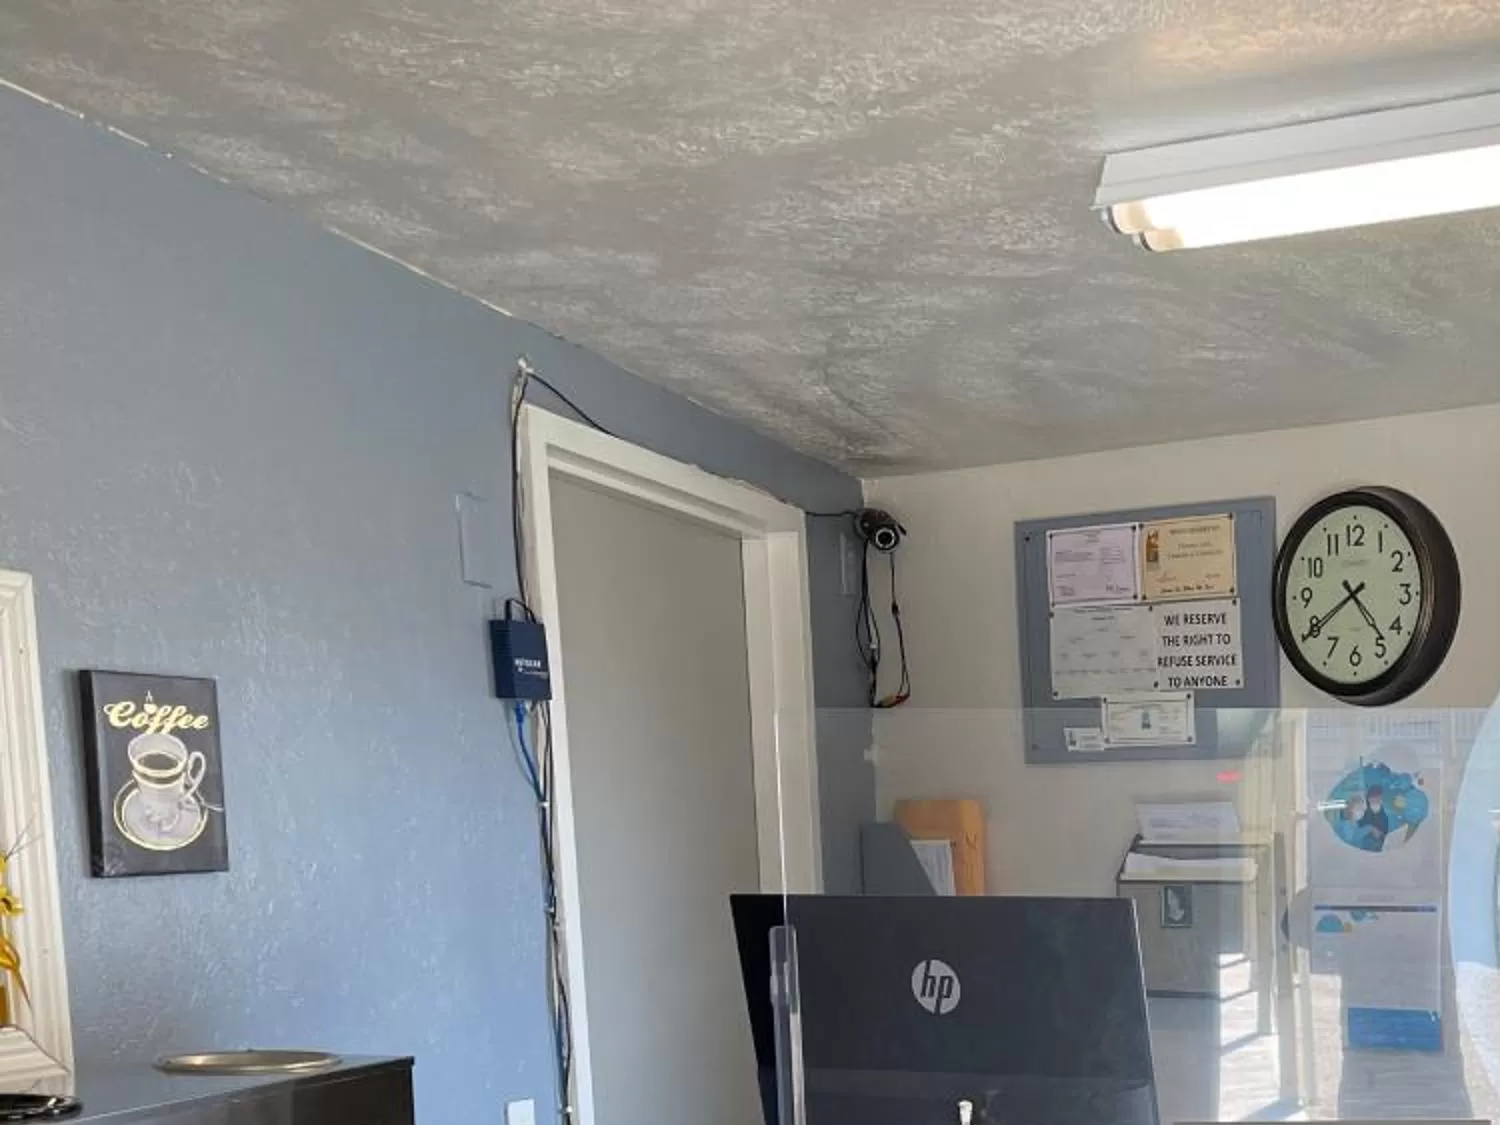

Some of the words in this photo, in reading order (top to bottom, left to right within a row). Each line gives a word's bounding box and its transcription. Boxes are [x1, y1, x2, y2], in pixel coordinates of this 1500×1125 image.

[1327, 534, 1339, 556] 11
[1346, 524, 1365, 547] 12
[1378, 531, 1383, 553] 1
[1308, 557, 1324, 578] 10
[1390, 550, 1403, 572] 2
[1300, 587, 1313, 608] 9
[1399, 583, 1412, 605] 3
[1163, 614, 1180, 626] WE
[1183, 612, 1227, 625] RESERVE
[1309, 615, 1322, 638] 8
[1389, 616, 1403, 636] 4
[1162, 635, 1181, 648] THE
[1182, 634, 1213, 647] RIGHT
[1215, 633, 1231, 645] TO
[1327, 635, 1340, 658] 7
[1374, 637, 1387, 659] 5
[1158, 656, 1193, 668] REFUSE
[1195, 654, 1236, 667] SERVICE
[1349, 645, 1362, 667] 6
[1168, 677, 1181, 689] TO
[1184, 675, 1228, 688] ANYONE
[103, 701, 209, 735] Coffee
[919, 959, 954, 1015] hp
